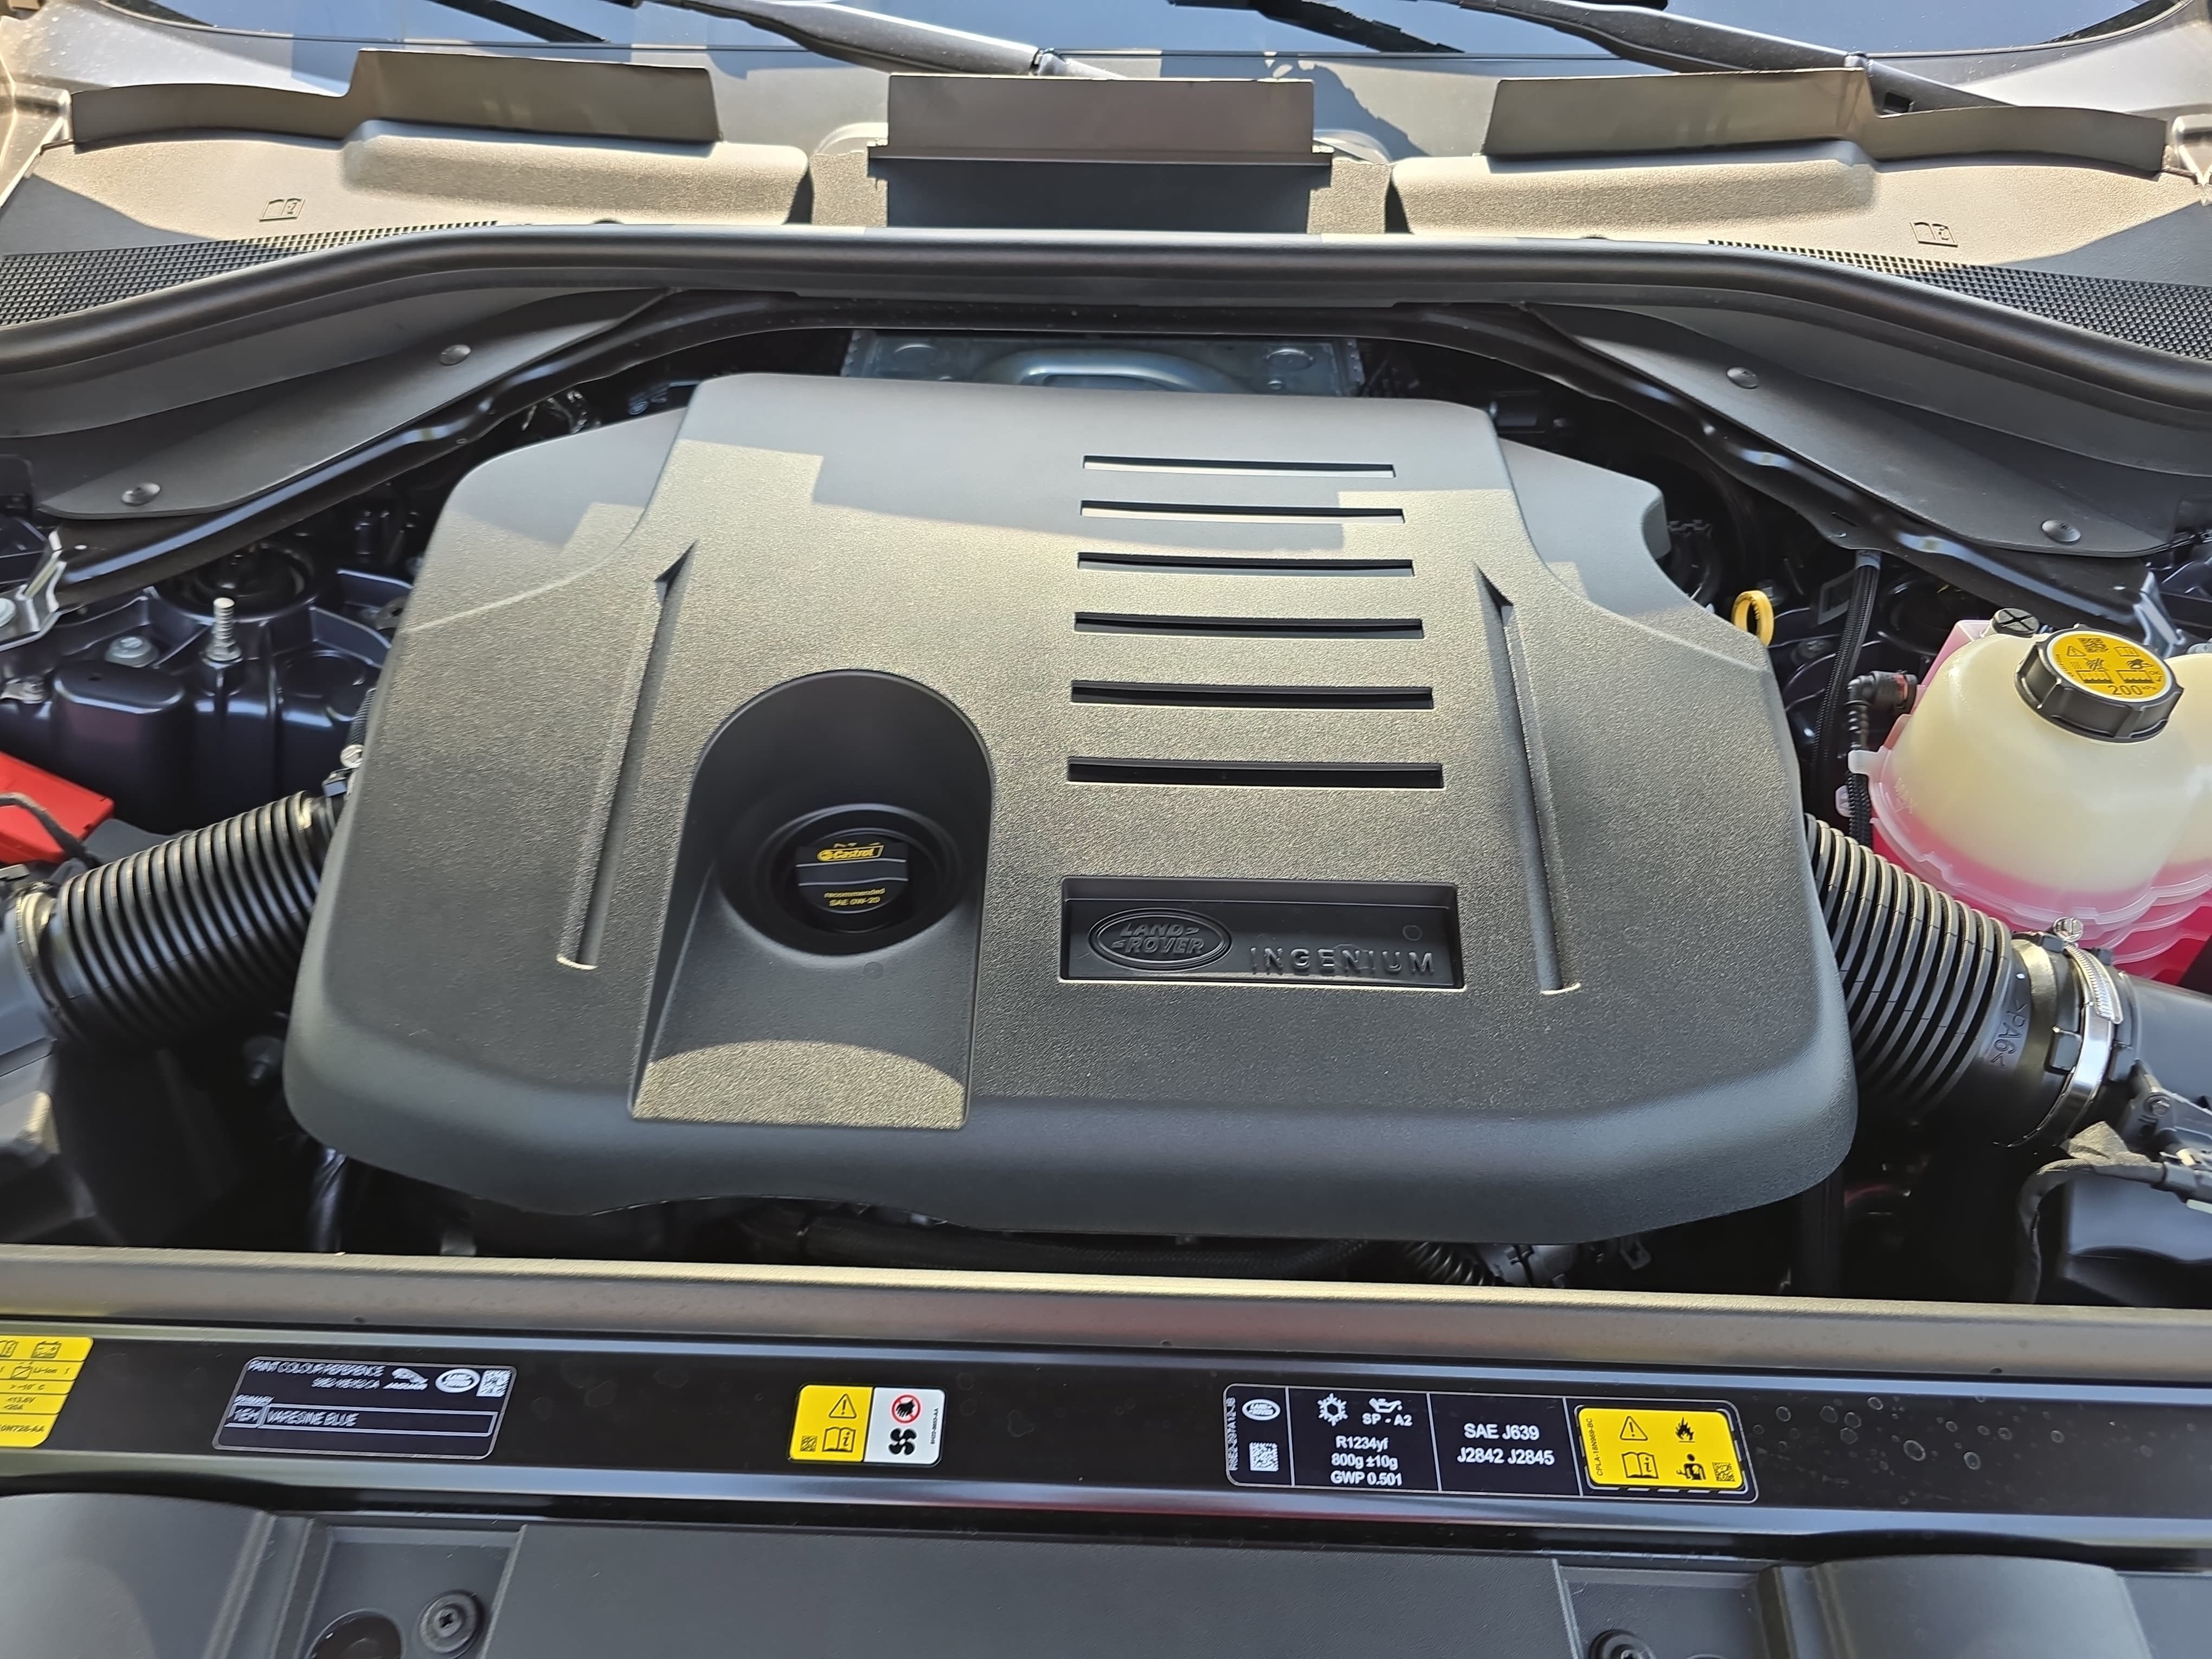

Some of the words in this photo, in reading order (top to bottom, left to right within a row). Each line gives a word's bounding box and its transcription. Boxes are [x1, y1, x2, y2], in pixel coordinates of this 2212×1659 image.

[2107, 685, 2143, 695] 200
[834, 848, 874, 859] Castrol
[1120, 923, 1184, 937] LAND
[1124, 936, 1205, 954] ROVER
[1250, 947, 1435, 974] INGENIUM
[1362, 1413, 1381, 1425] SP
[1393, 1414, 1413, 1426] A2
[1464, 1423, 1500, 1439] SAE
[1502, 1424, 1540, 1441] J639
[1335, 1435, 1389, 1452] R1234yf
[1331, 1452, 1364, 1470] 800g
[1457, 1446, 1505, 1464] J2842
[1507, 1449, 1555, 1465] J2845
[1330, 1470, 1366, 1484] GWP
[1366, 1471, 1403, 1486] 0.501
